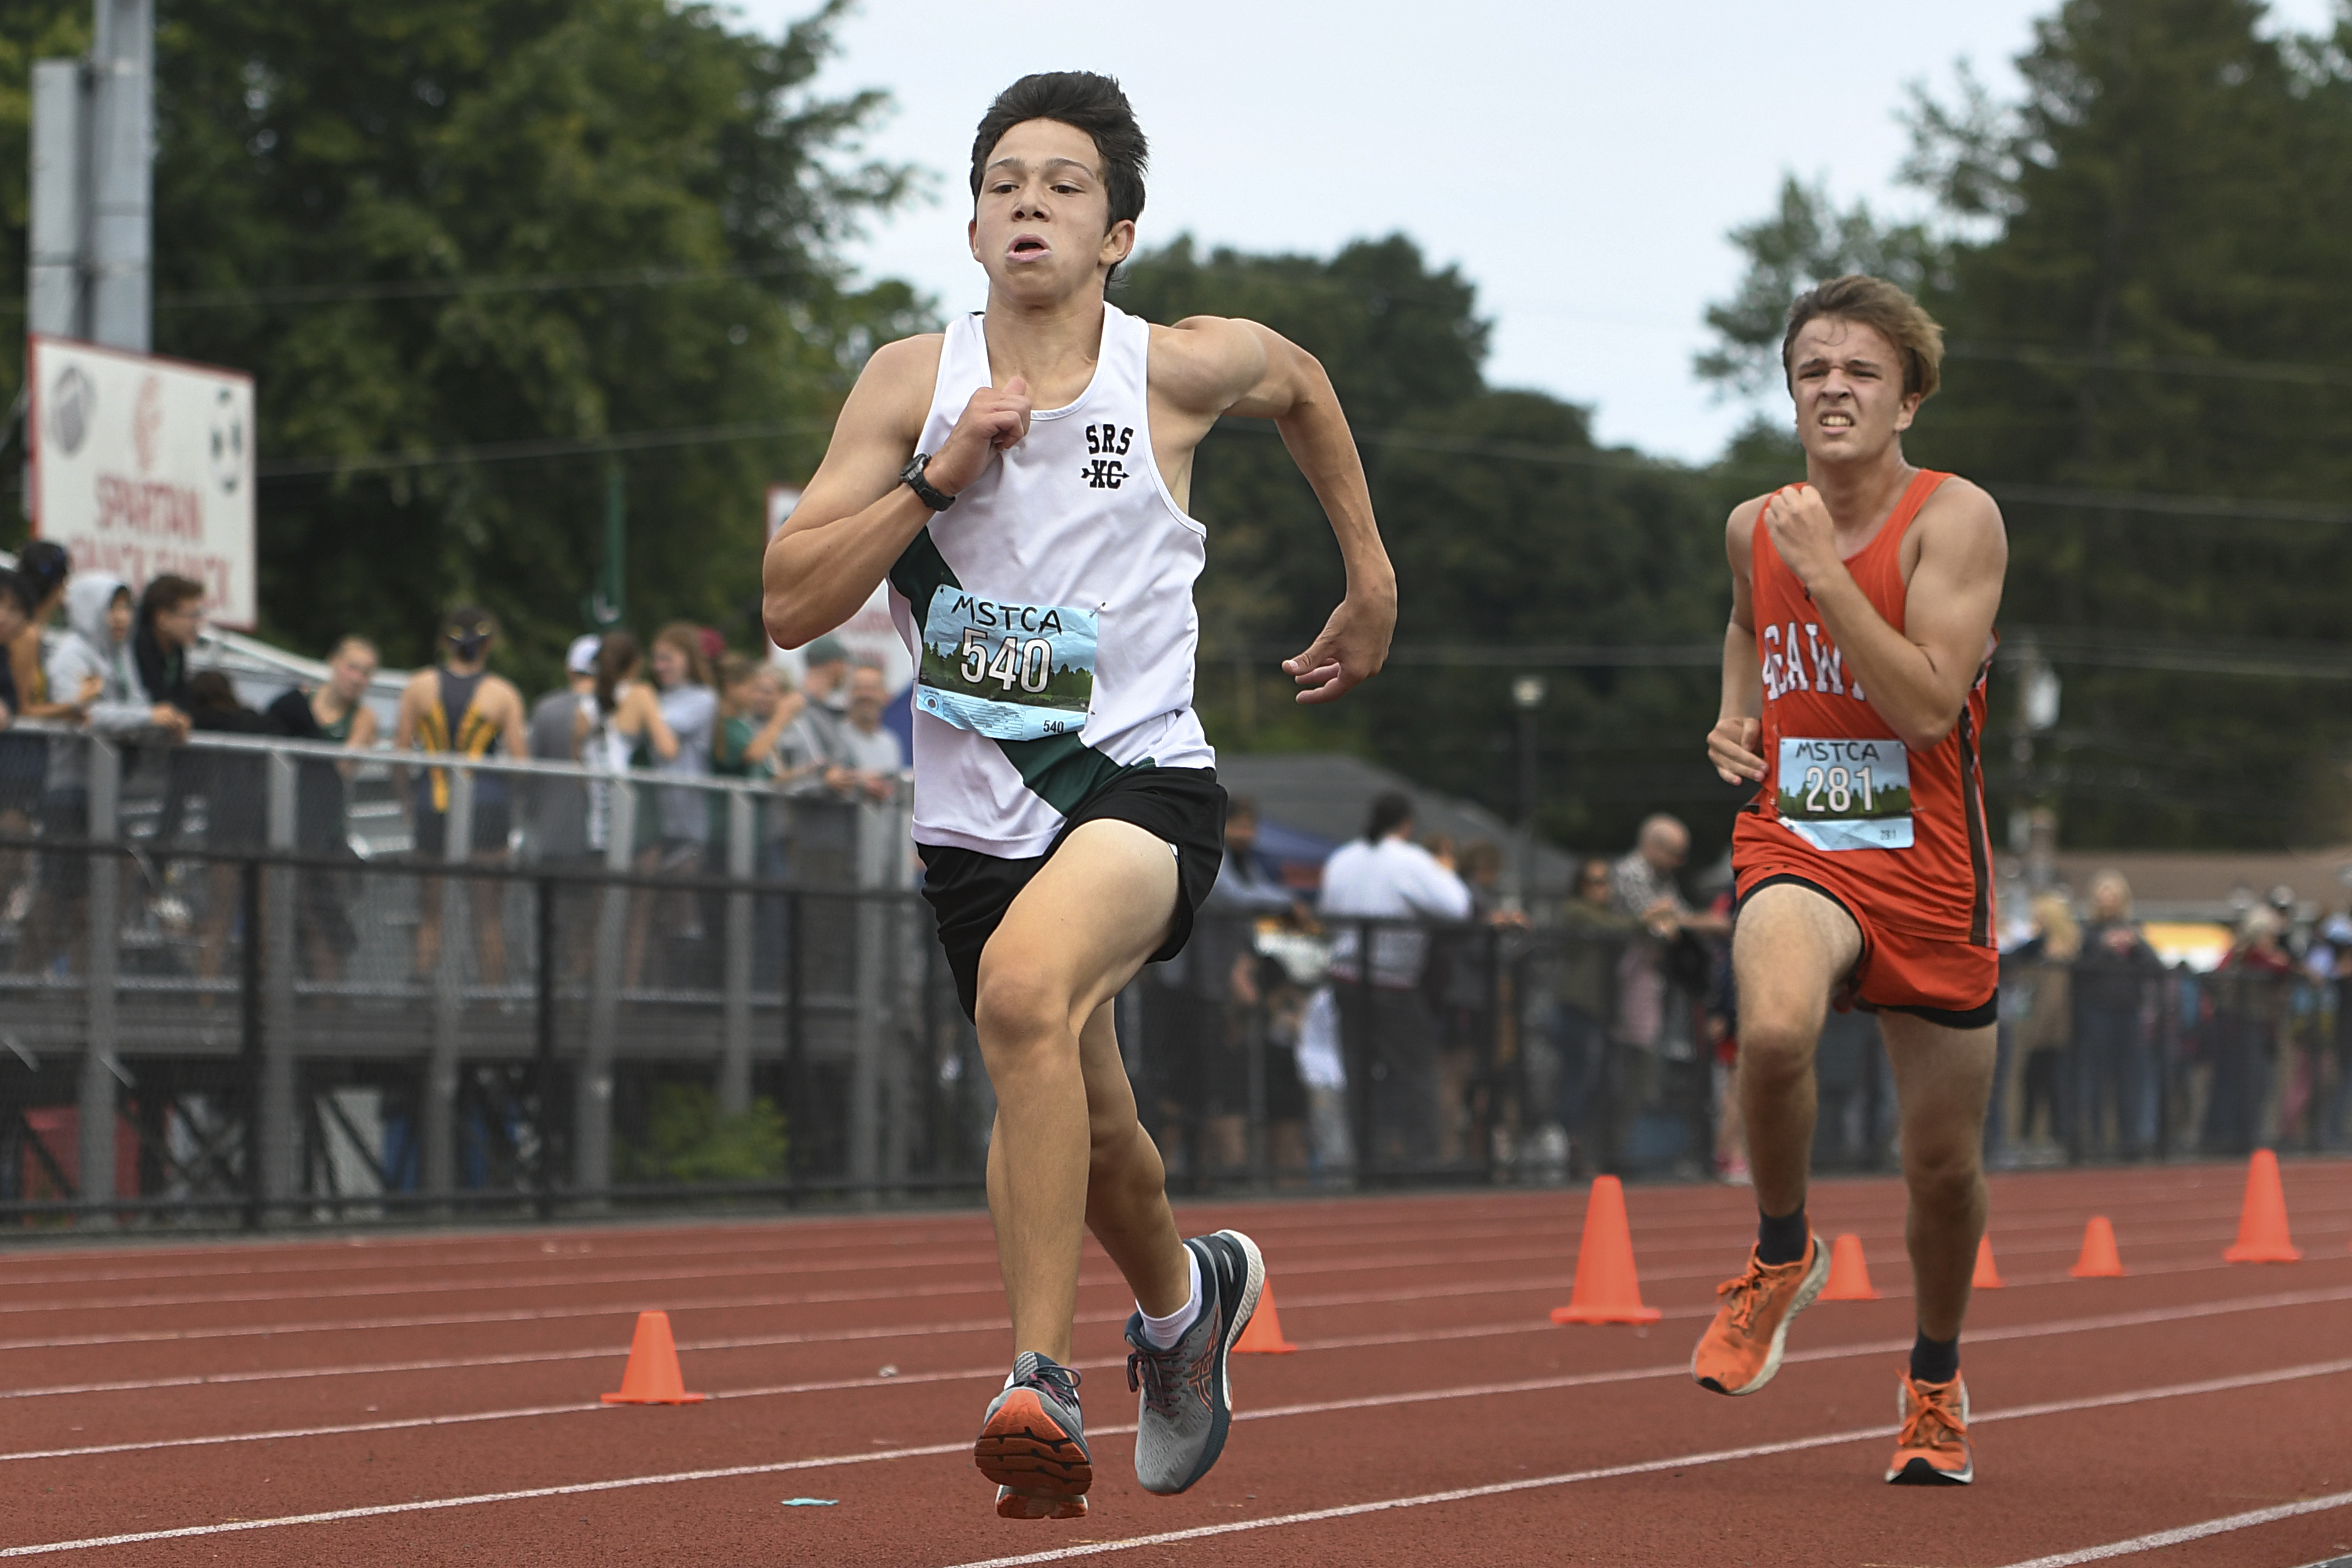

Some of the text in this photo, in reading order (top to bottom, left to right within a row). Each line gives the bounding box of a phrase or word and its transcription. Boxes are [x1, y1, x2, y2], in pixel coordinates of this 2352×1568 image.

[1085, 424, 1134, 456] SRS
[1089, 459, 1123, 489] XC
[951, 595, 1062, 635] MSTCA
[960, 626, 1053, 693] 540
[1043, 720, 1064, 733] 540
[1796, 742, 1879, 762] MSTCA
[1805, 766, 1874, 813] 281
